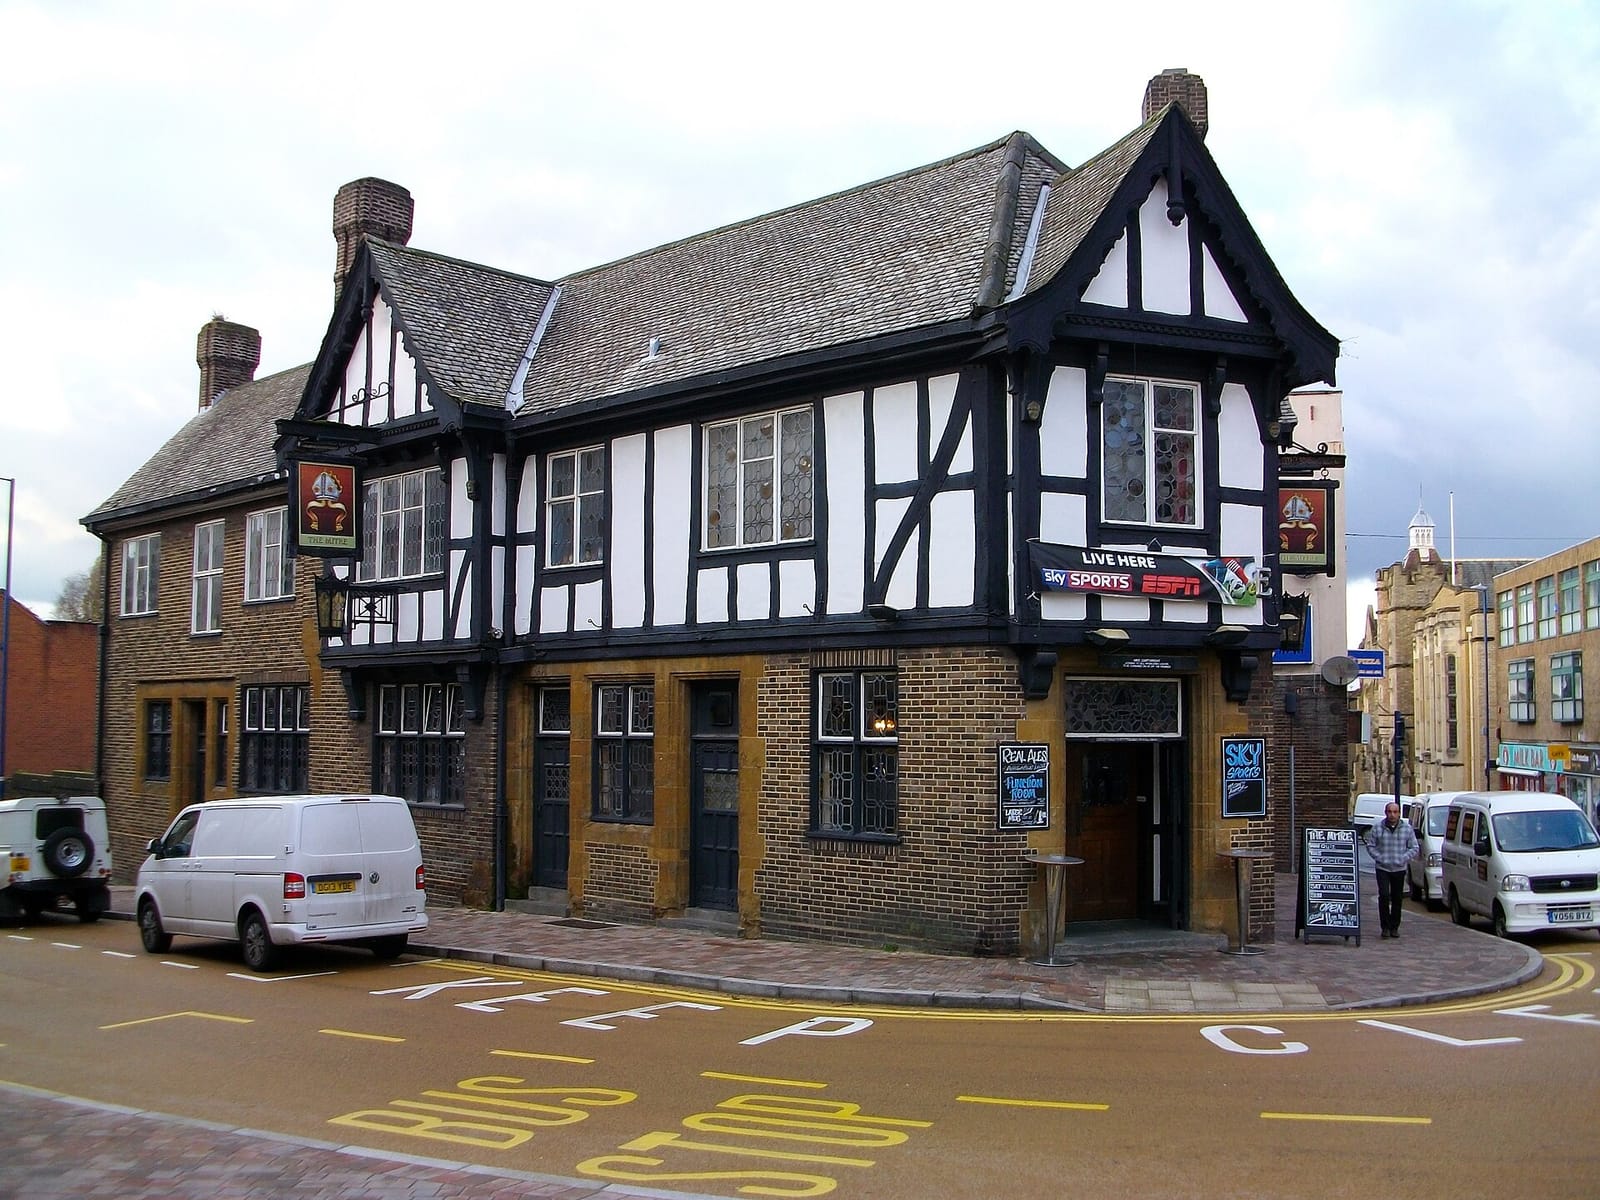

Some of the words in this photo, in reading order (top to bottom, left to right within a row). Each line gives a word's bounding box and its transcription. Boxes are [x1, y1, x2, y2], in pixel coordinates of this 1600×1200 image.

[307, 536, 324, 545] THE
[326, 537, 348, 545] MITRE
[1081, 551, 1115, 566] LIVE
[1117, 553, 1157, 569] HERE
[1044, 569, 1066, 587] sky
[1069, 572, 1130, 590] SPORTS
[1141, 574, 1201, 596] ESPN
[1225, 742, 1262, 766] SKY
[1226, 766, 1261, 779] SPORTS
[1005, 774, 1043, 790] FUNCTION
[1010, 788, 1037, 800] ROOM
[1308, 830, 1326, 841] THE
[1327, 831, 1354, 842] MITRE
[1319, 902, 1345, 913] OPEN
[369, 976, 874, 1045] KEEP
[1198, 1003, 1600, 1056] CLE
[326, 1076, 638, 1150] BUS
[576, 1094, 934, 1198] STOP
